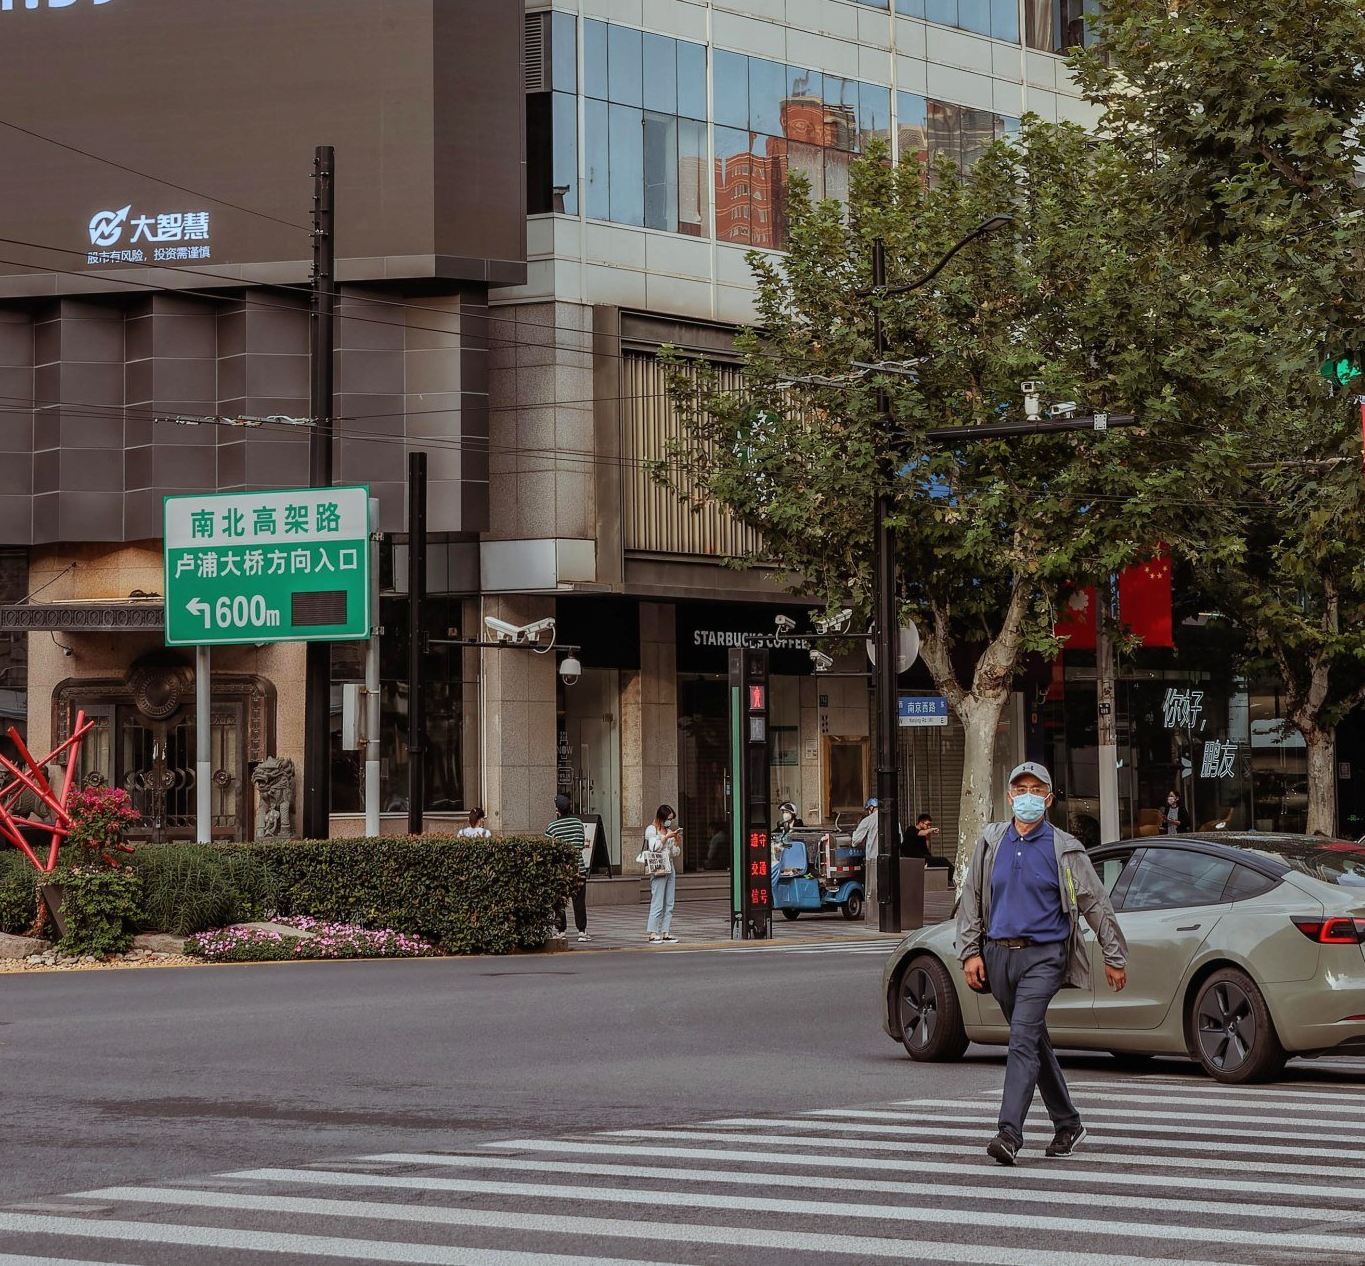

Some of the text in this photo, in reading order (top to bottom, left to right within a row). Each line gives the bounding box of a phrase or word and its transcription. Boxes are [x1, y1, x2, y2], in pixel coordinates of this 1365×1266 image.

[130, 211, 210, 243] 大智慧
[191, 502, 341, 538] 南北高架路
[175, 547, 358, 579] 卢浦大桥方向入口
[215, 594, 280, 629] 600m
[907, 701, 936, 713] 南京西路
[751, 833, 767, 847] 遵守
[751, 861, 767, 876] 交通
[751, 889, 768, 904] 信号
